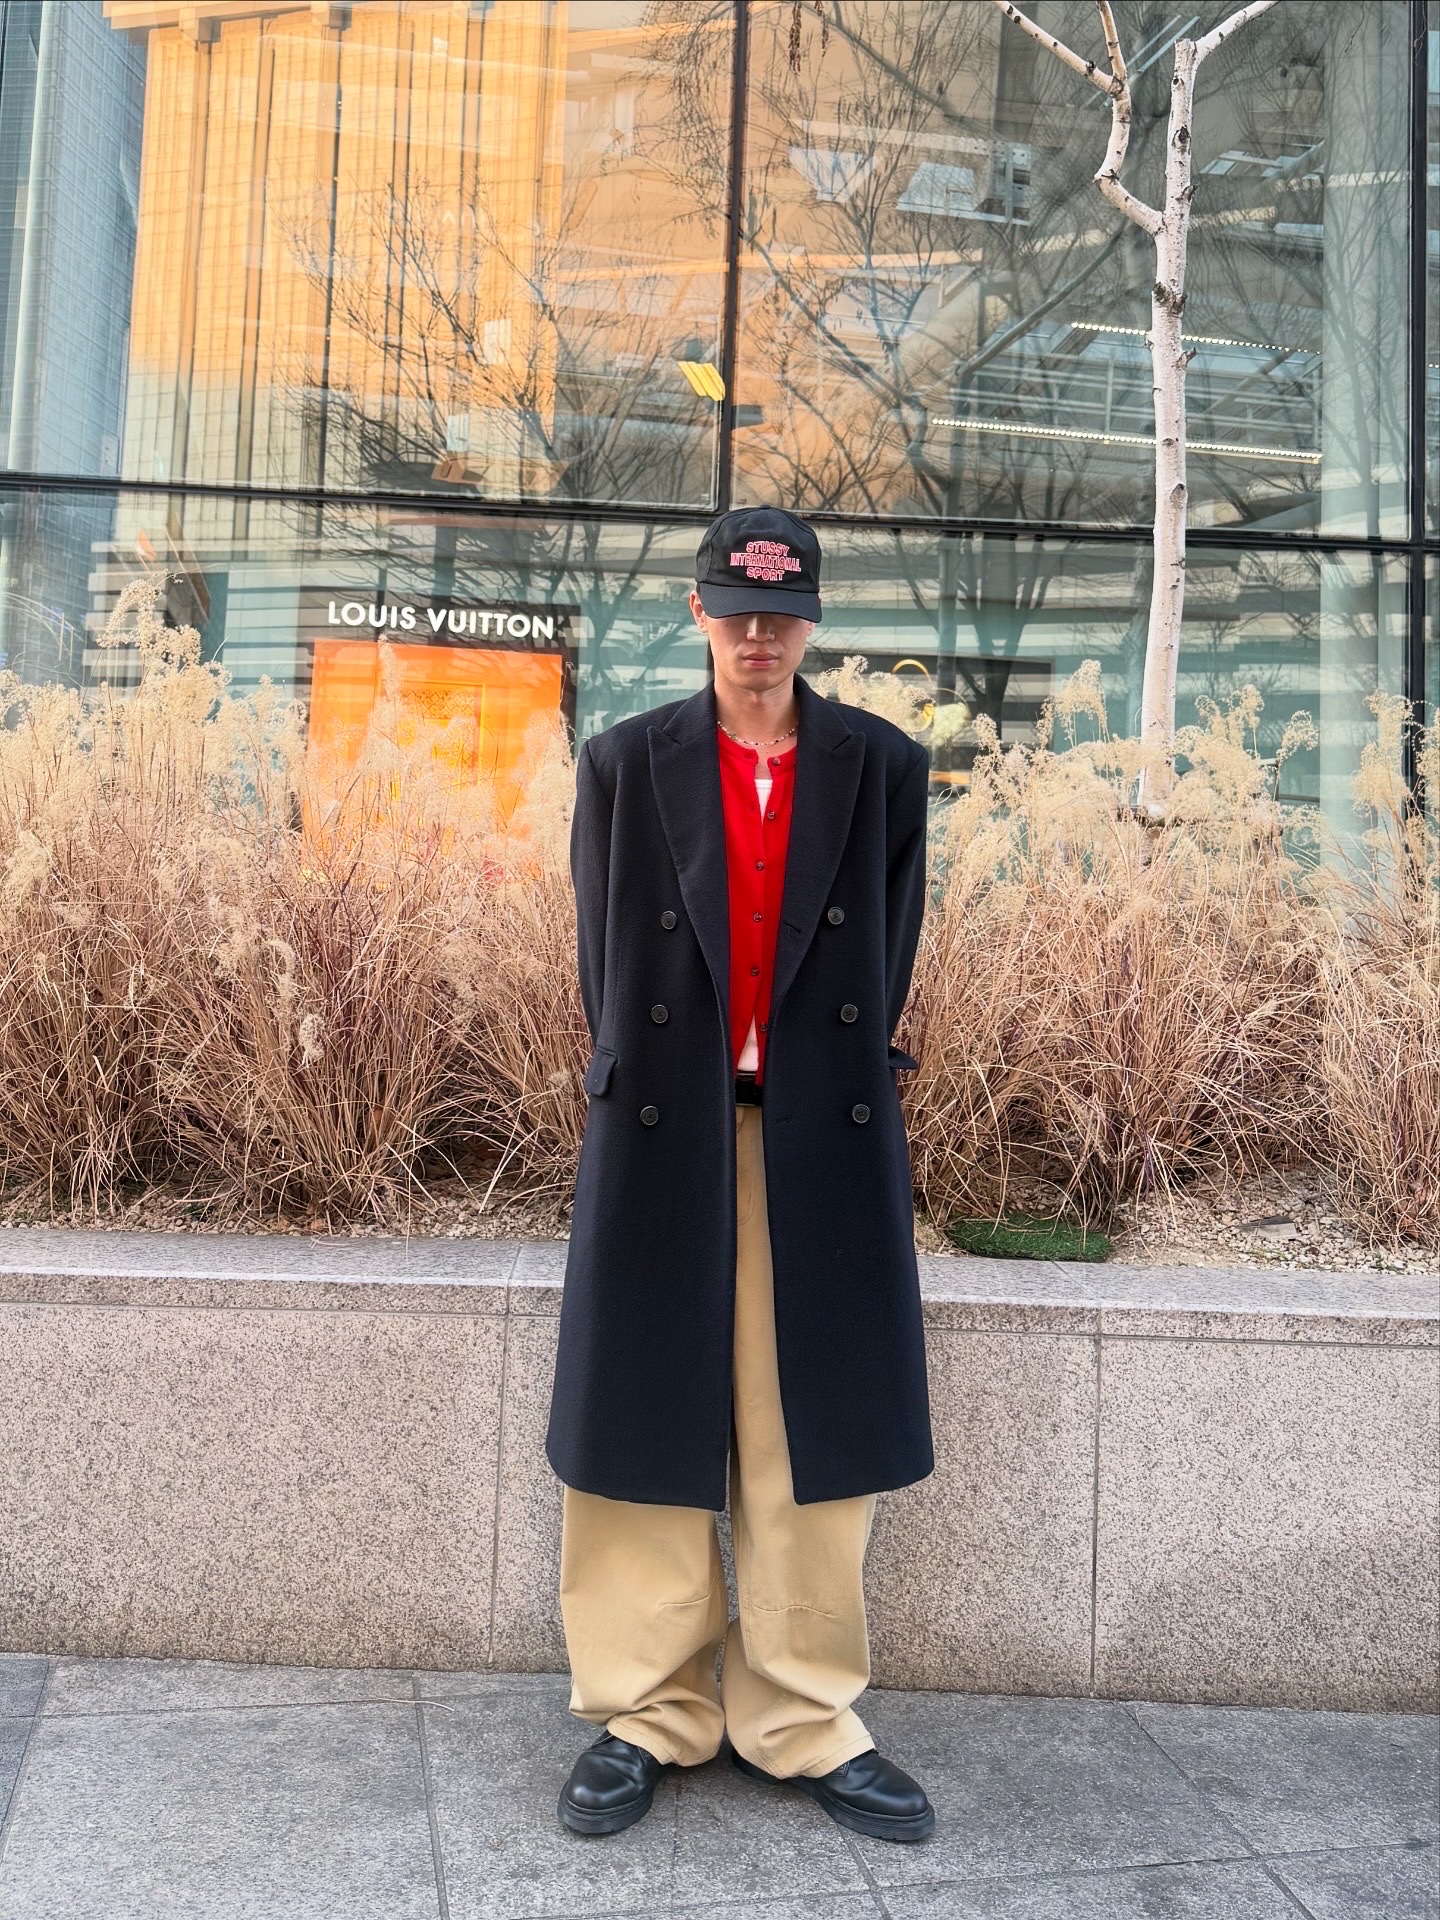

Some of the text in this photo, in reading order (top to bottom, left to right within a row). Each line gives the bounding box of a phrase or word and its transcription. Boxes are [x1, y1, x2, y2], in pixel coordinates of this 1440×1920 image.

[746, 541, 789, 556] STUSSY
[730, 553, 801, 572] INTERNATIONAL
[746, 567, 785, 581] SPORT
[328, 601, 554, 640] LOUIS VUITTON
